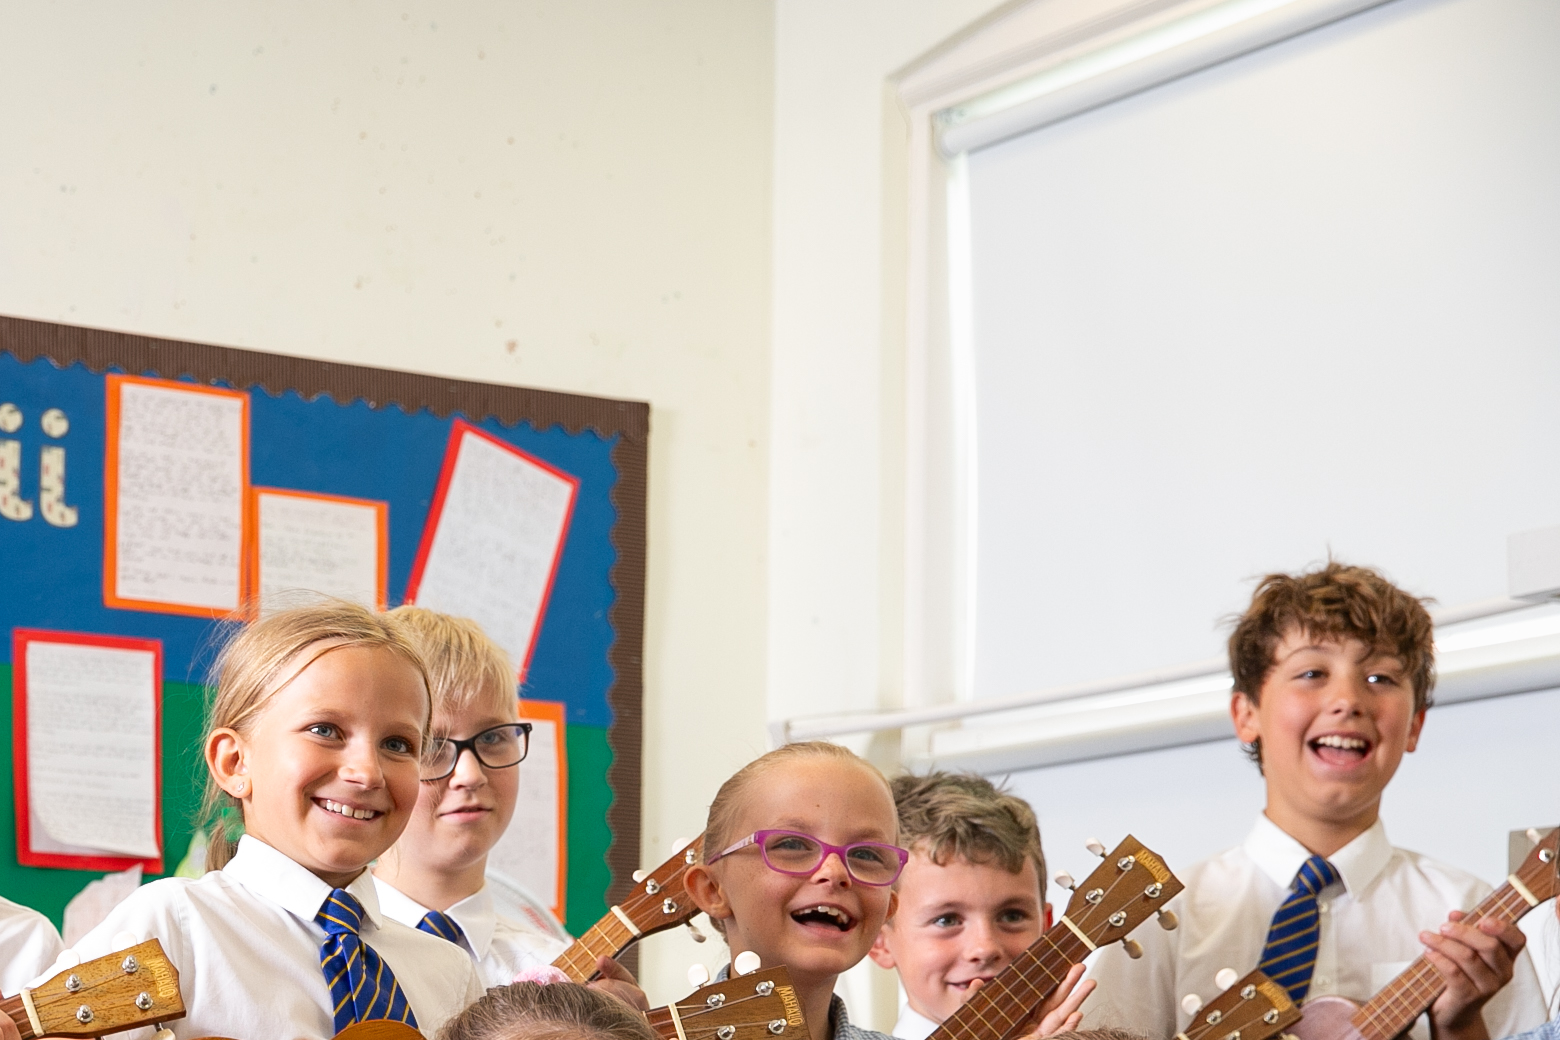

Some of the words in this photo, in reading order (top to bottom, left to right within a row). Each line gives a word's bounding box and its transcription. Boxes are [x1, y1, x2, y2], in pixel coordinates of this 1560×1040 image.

[1135, 848, 1171, 884] MAHALO
[143, 957, 178, 998] MAHALO
[775, 984, 806, 1028] MAHALO
